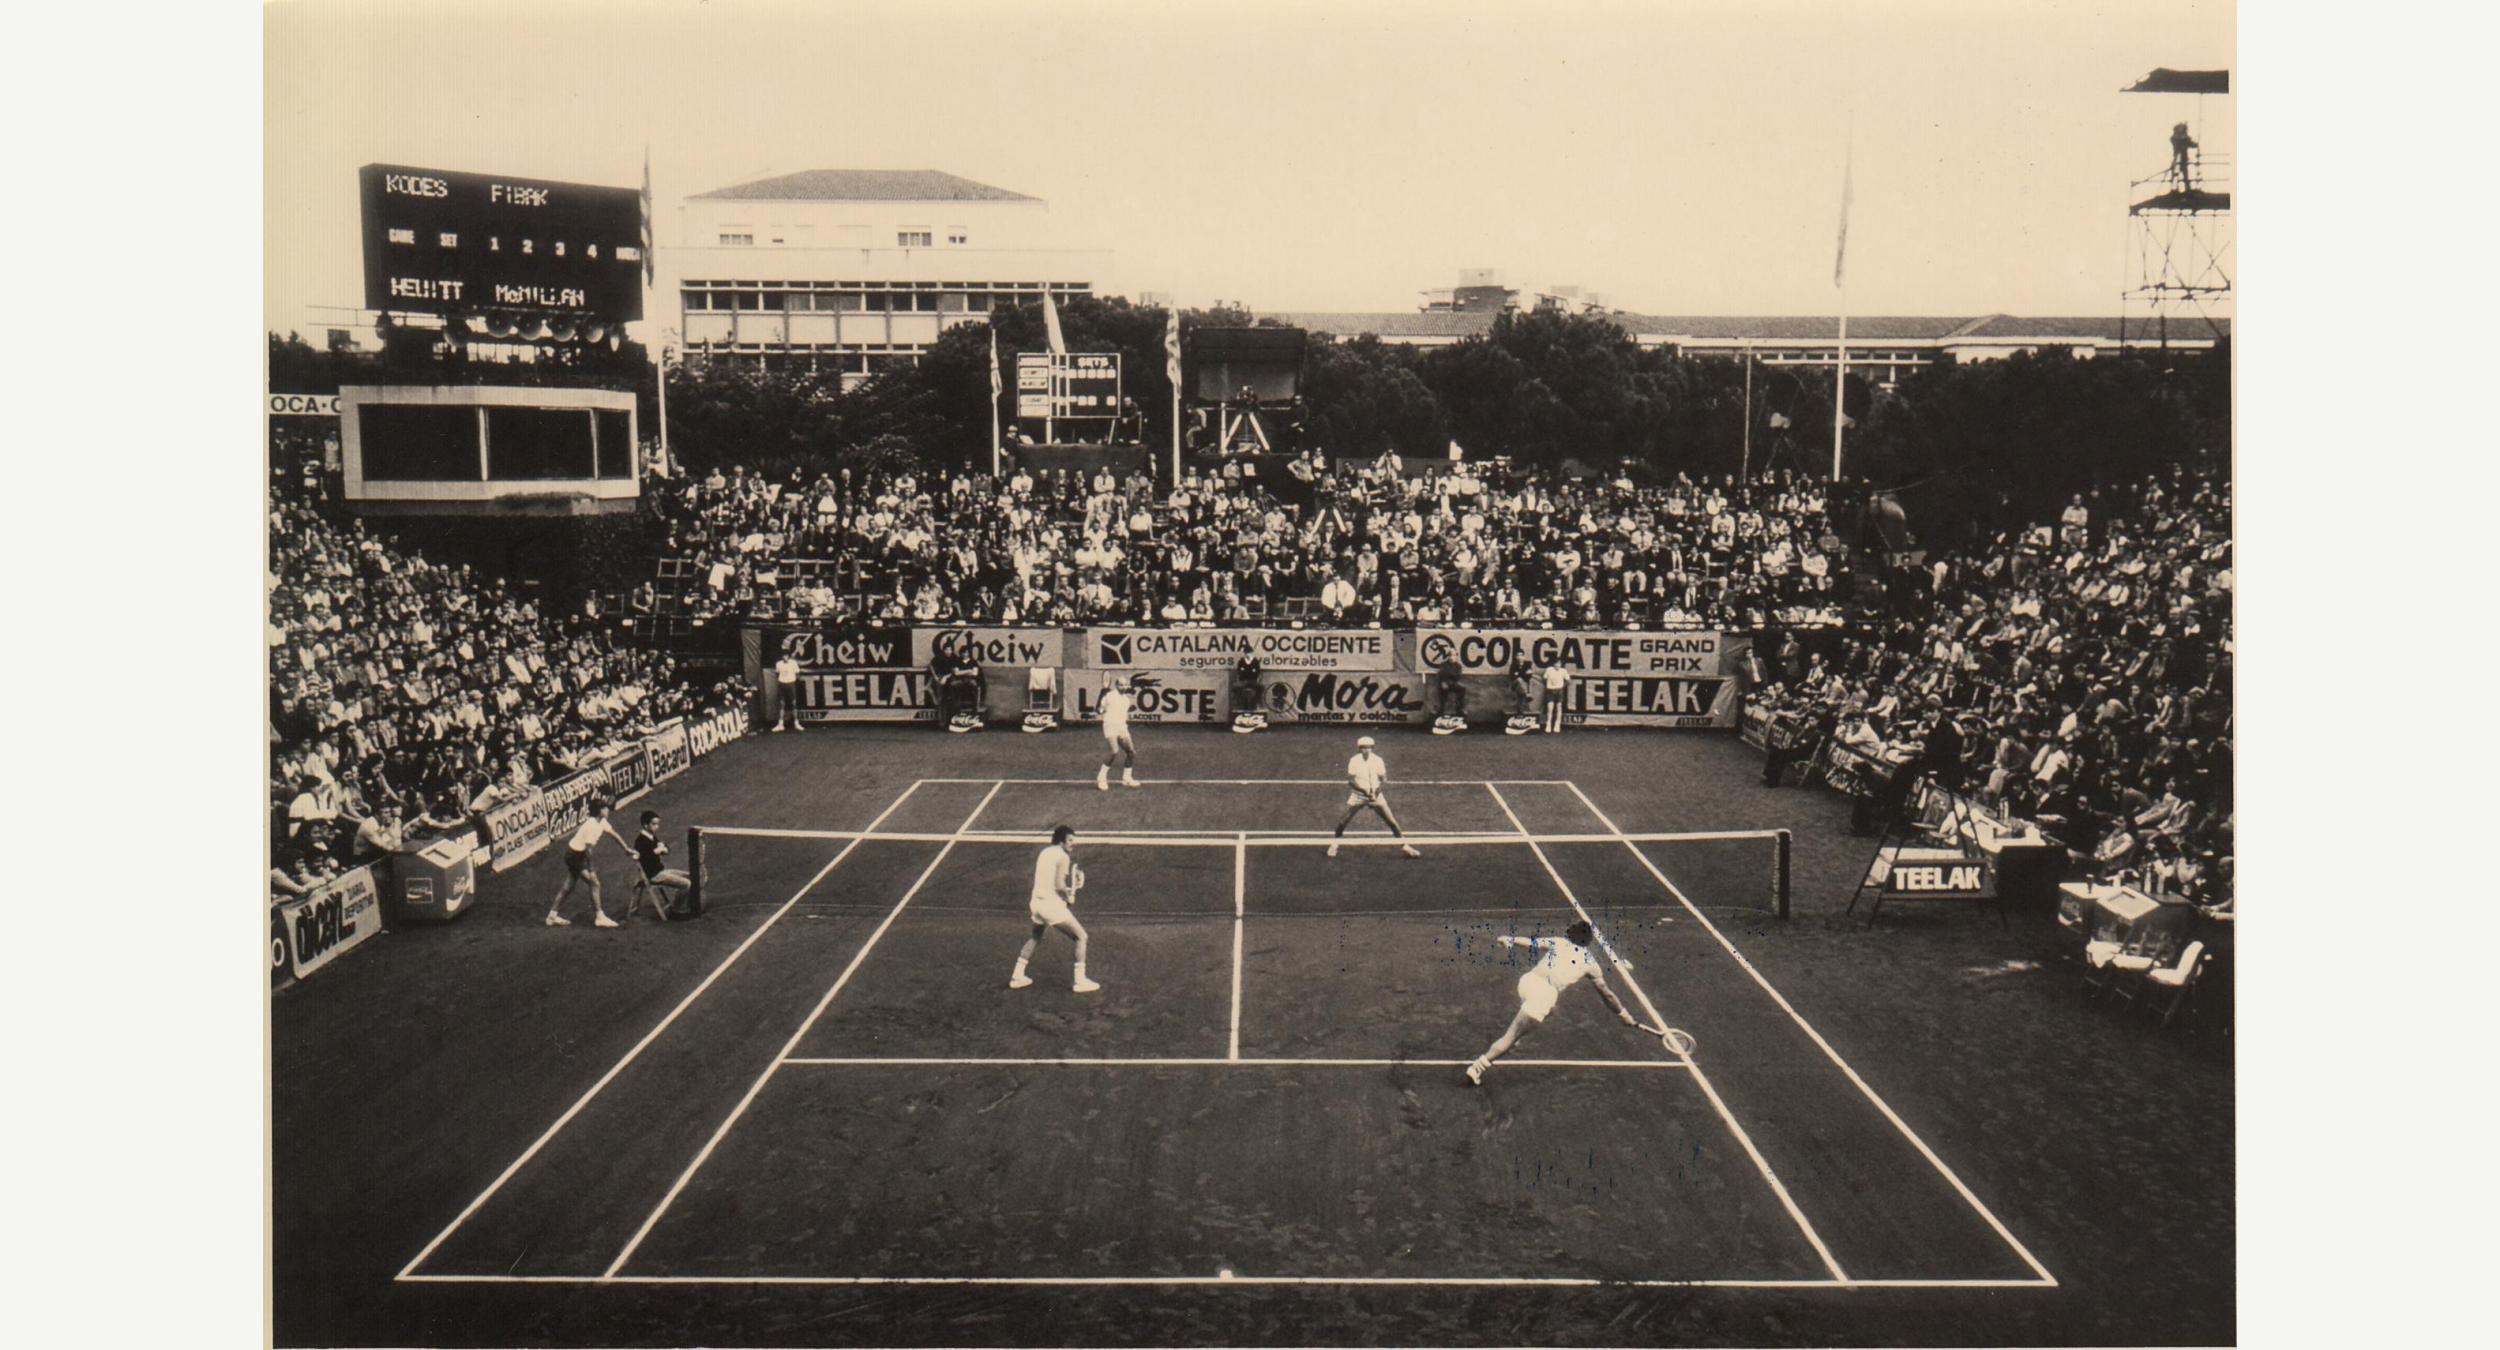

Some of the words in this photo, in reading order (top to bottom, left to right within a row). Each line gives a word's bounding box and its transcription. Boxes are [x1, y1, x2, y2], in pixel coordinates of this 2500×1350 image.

[386, 173, 448, 198] KODES
[491, 237, 499, 250] 1
[523, 240, 532, 253] 2
[556, 242, 565, 256] 3
[587, 245, 597, 258] 4
[1640, 639, 1714, 653] GRAND
[1180, 656, 1235, 669] seguros
[1650, 657, 1702, 671] PRIX
[1296, 673, 1424, 711] Mora
[1567, 679, 1701, 712] TEELAK
[1348, 712, 1356, 722] y
[1893, 867, 1982, 890] TEELAK
